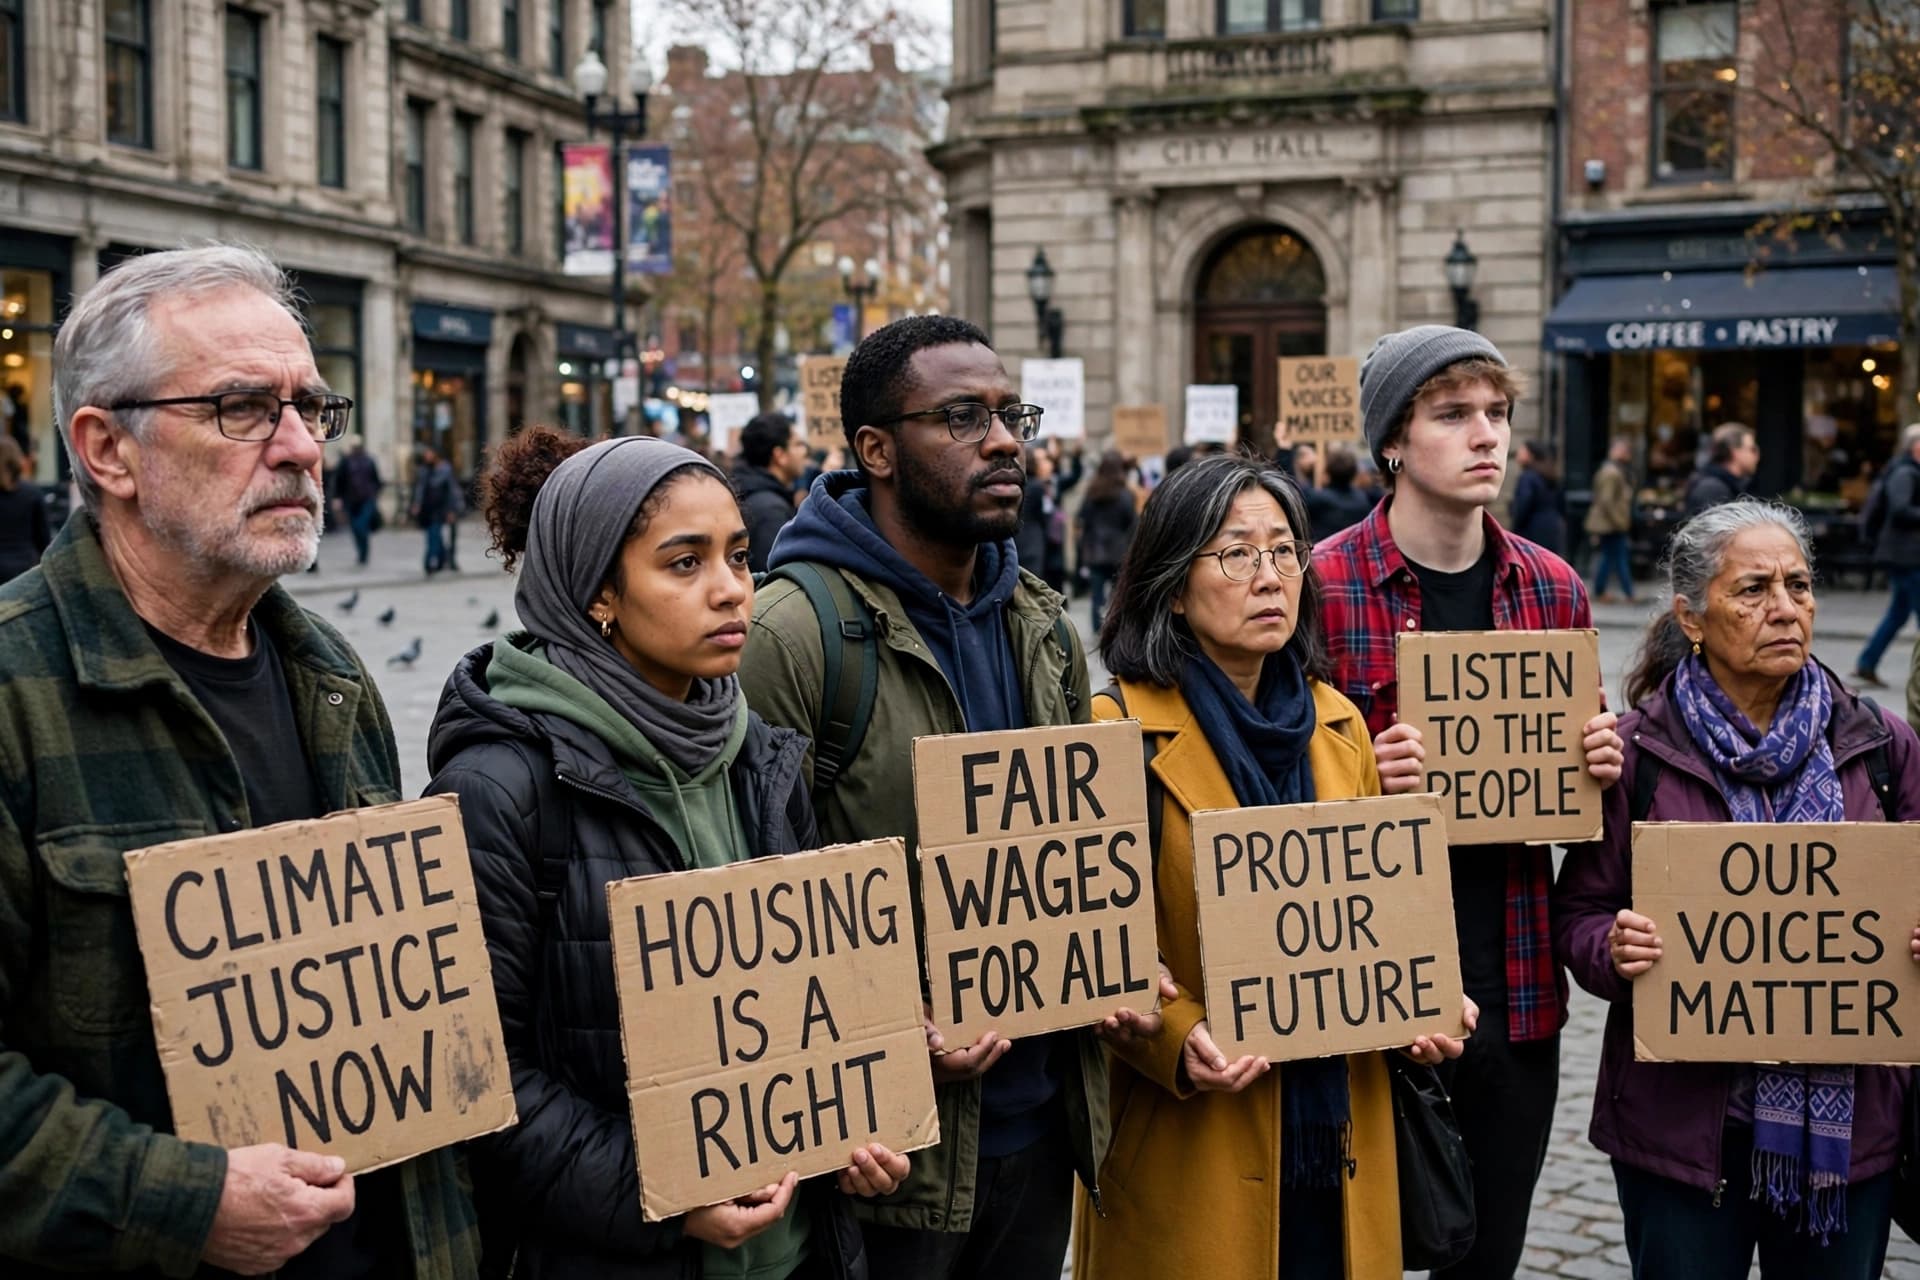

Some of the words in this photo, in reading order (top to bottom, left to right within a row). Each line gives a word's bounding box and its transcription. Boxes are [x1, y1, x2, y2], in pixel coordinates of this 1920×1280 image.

[1162, 136, 1232, 164] CITY
[1252, 130, 1331, 159] HALL
[1606, 320, 1705, 349] COFFEE
[1737, 317, 1838, 346] PASTRY
[1287, 385, 1353, 408] VOICES
[1295, 363, 1336, 383] OUR
[1286, 411, 1355, 433] MATTER
[1423, 650, 1573, 702] LISTEN
[1428, 715, 1480, 756] TO
[1493, 711, 1567, 754] THE
[961, 741, 1107, 835] FAIR
[1426, 765, 1581, 820] PEOPLE
[934, 830, 1141, 931] WAGES
[1213, 817, 1431, 897] PROTECT
[1719, 841, 1841, 897] OUR
[164, 824, 455, 961] CLIMATE
[634, 866, 899, 993] HOUSING
[1276, 894, 1380, 958] OUR
[1677, 909, 1885, 965] VOICES
[185, 922, 471, 1068] JUSTICE
[948, 939, 1045, 1025] FOR
[1060, 923, 1149, 1005] ALL
[1230, 955, 1441, 1042] FUTURE
[713, 989, 769, 1067] IS
[800, 975, 841, 1050] A
[1669, 979, 1904, 1038] MATTER
[274, 1029, 435, 1150] NOW
[690, 1049, 887, 1179] RIGHT
